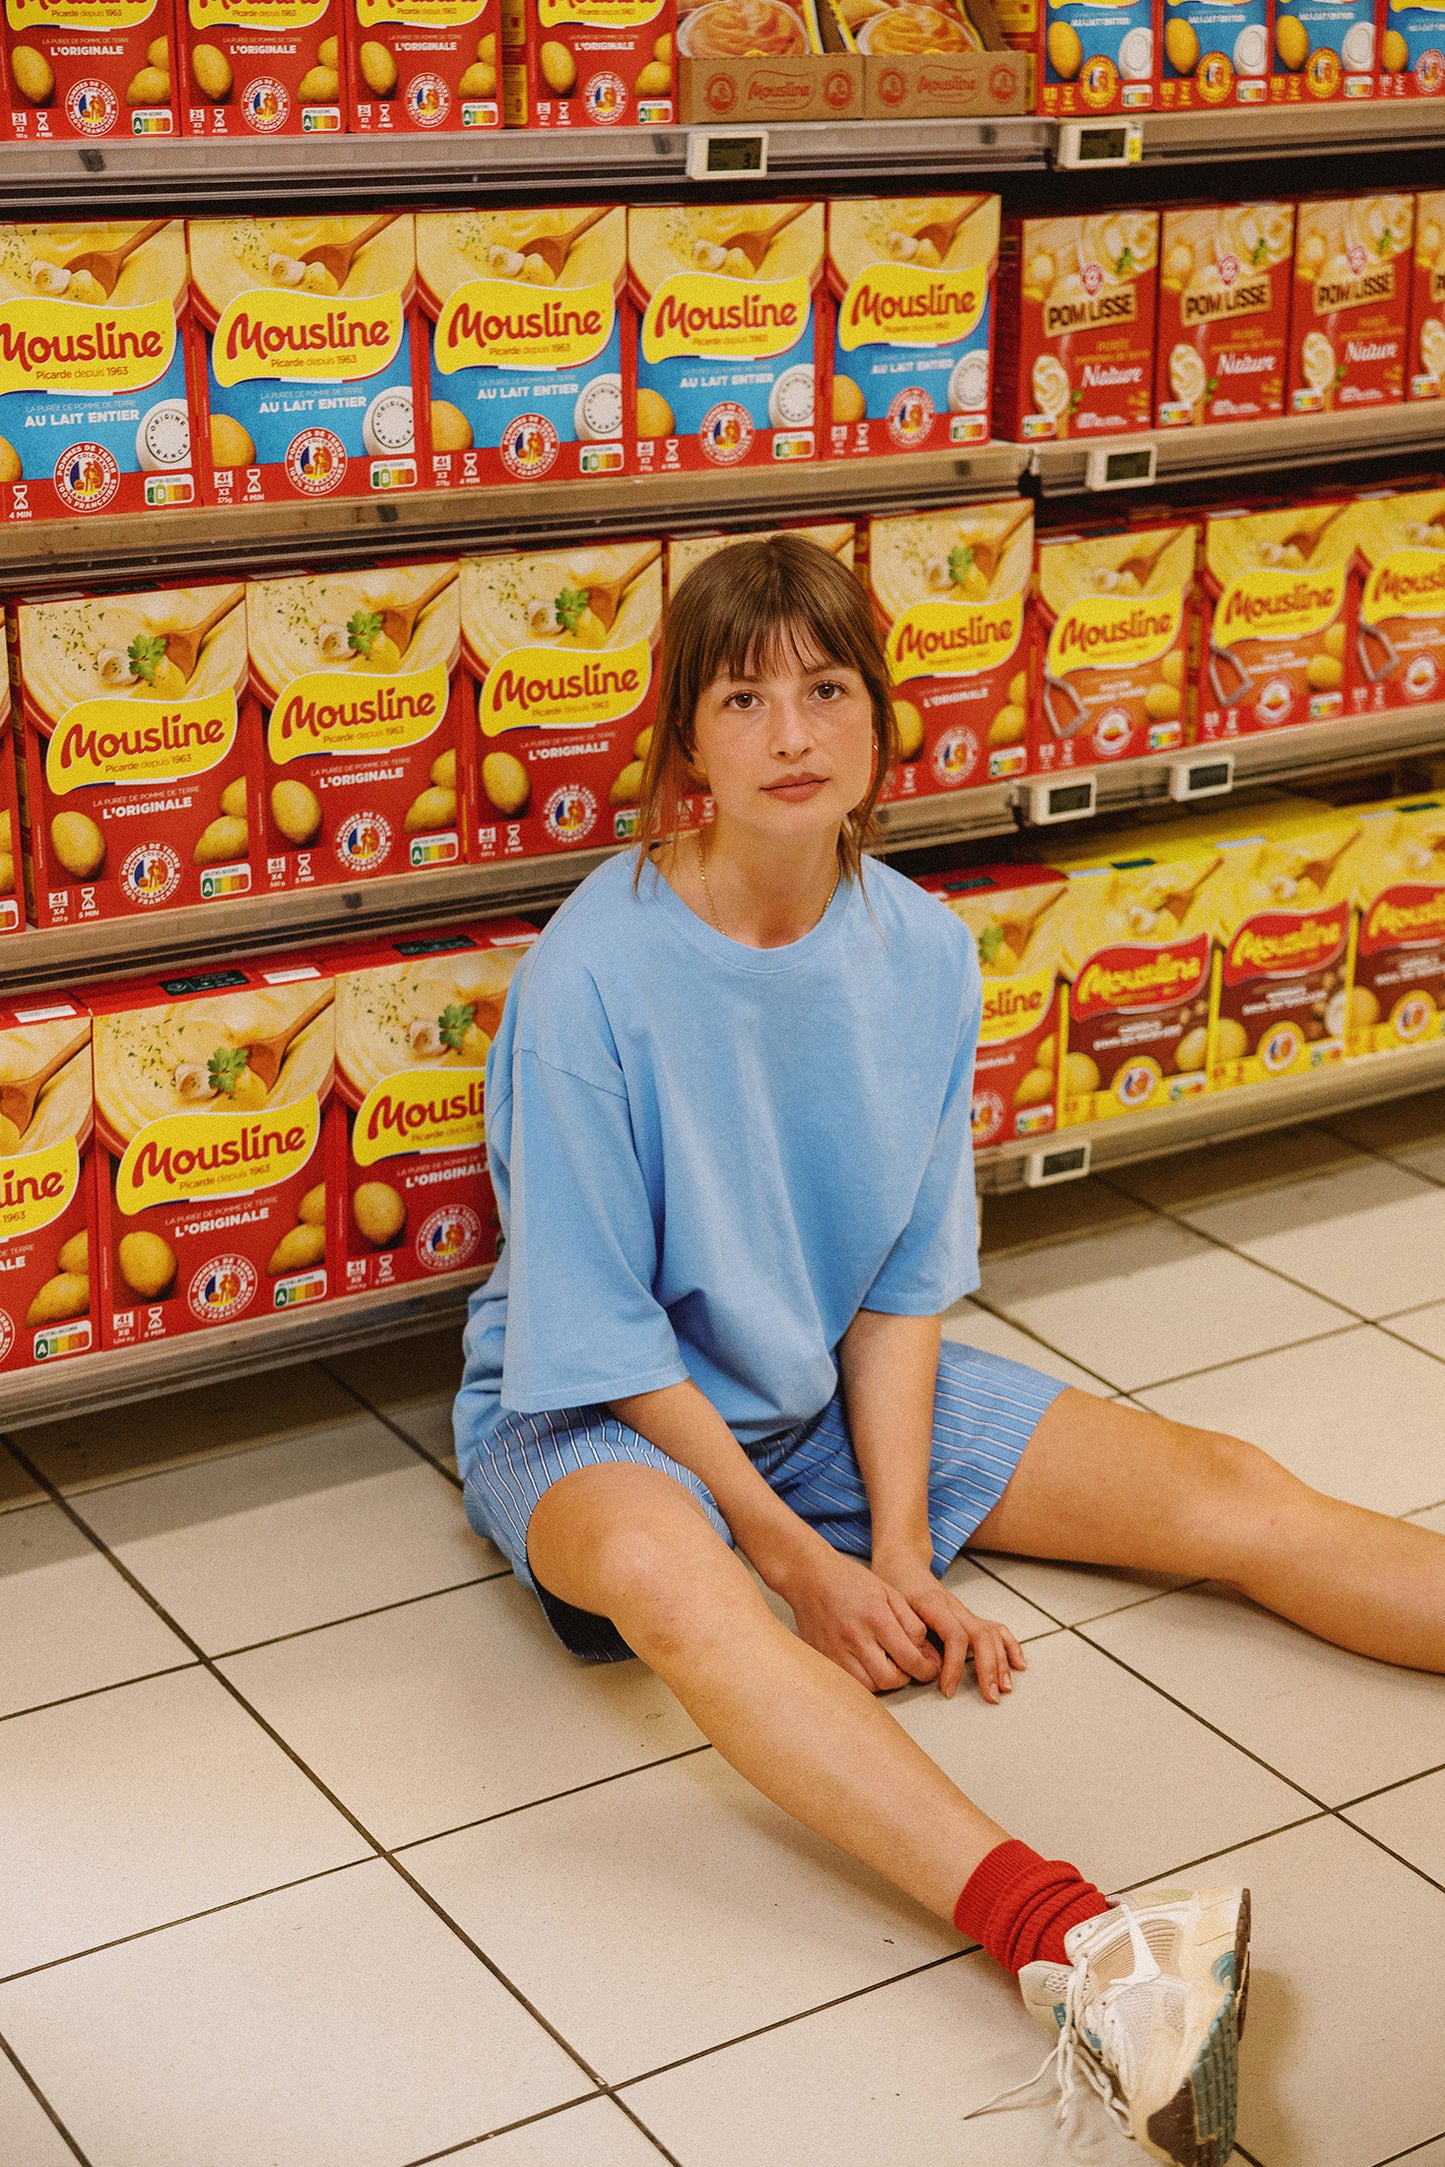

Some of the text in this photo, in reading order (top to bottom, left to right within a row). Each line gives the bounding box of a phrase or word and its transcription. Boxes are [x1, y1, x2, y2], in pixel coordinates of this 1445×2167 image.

[50, 46, 124, 56] L'ORIGINALE
[230, 46, 296, 54] L'ORIGINALE
[851, 284, 977, 326] Mousline
[448, 302, 602, 348] Mousline
[654, 294, 798, 339] Mousline
[1048, 303, 1086, 329] POM
[226, 312, 390, 360] Mousline
[271, 358, 303, 368] Picarde
[336, 354, 357, 364] 1963
[36, 366, 128, 380] Picarde depuis 1963
[477, 384, 579, 400] AU LAIT ENTIER
[259, 396, 367, 414] AU LAIT ENTIER
[24, 409, 140, 428] AU LAIT ENTIER
[150, 414, 186, 432] ORIGINE
[84, 444, 97, 452] DE
[248, 493, 264, 501] MIN
[9, 512, 16, 520] 4
[896, 614, 1014, 663] Mousline
[1059, 610, 1173, 654] Mousline
[492, 663, 640, 712] Mousline
[282, 687, 436, 740] Mousline
[60, 714, 225, 770] Mousline
[528, 741, 609, 761] L'ORIGINALE
[105, 762, 139, 774] Picarde
[172, 754, 192, 764] 1963
[320, 766, 404, 789] L'ORIGINALE
[102, 796, 193, 820] L'ORIGINALE
[132, 1124, 306, 1188] Mousline
[3, 1210, 26, 1223] 1963
[174, 1207, 270, 1238] L'ORIGINALE
[37, 1342, 48, 1356] A
